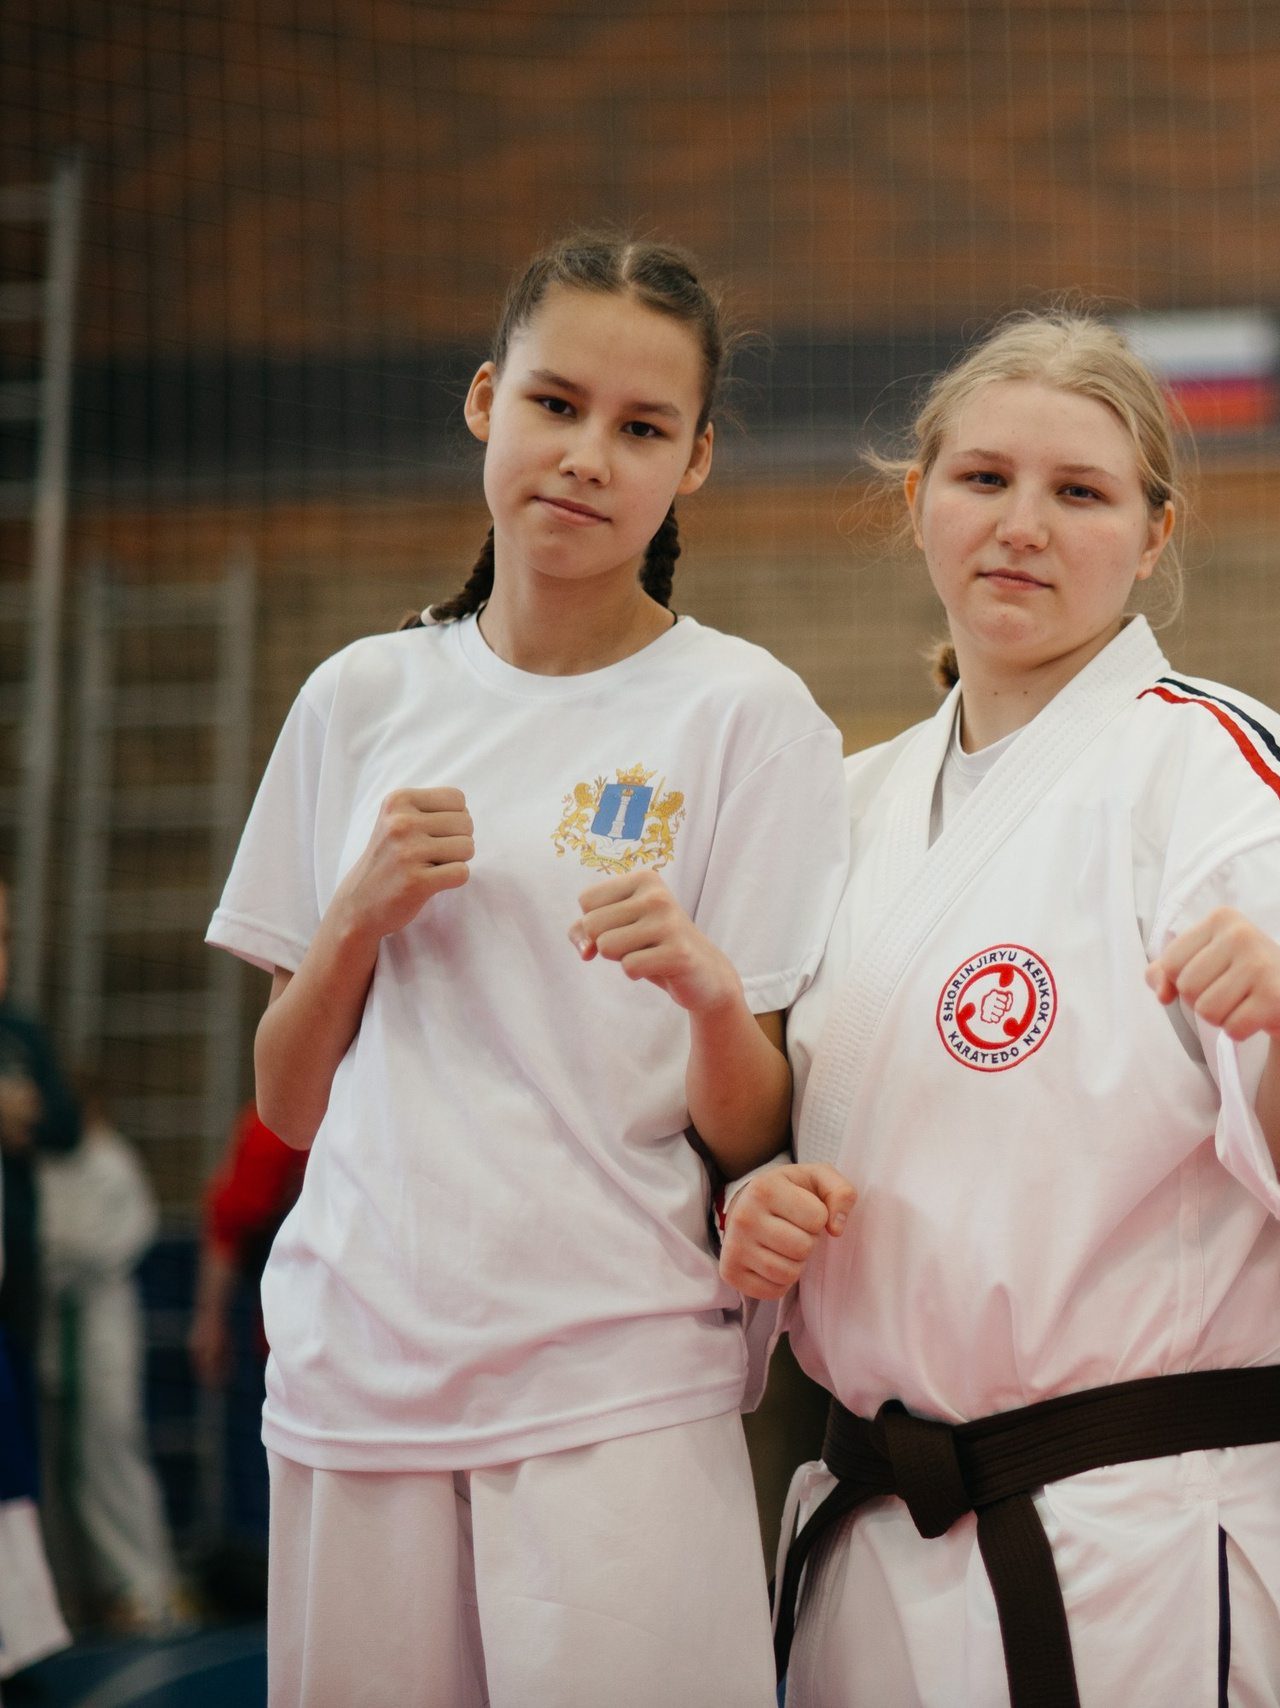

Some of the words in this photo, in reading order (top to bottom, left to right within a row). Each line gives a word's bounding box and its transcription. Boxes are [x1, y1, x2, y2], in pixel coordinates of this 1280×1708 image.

[943, 950, 1017, 1022] SHORINJIRYU
[1022, 958, 1050, 1046] KENKOKAN
[948, 1031, 1020, 1064] KARATEDO
